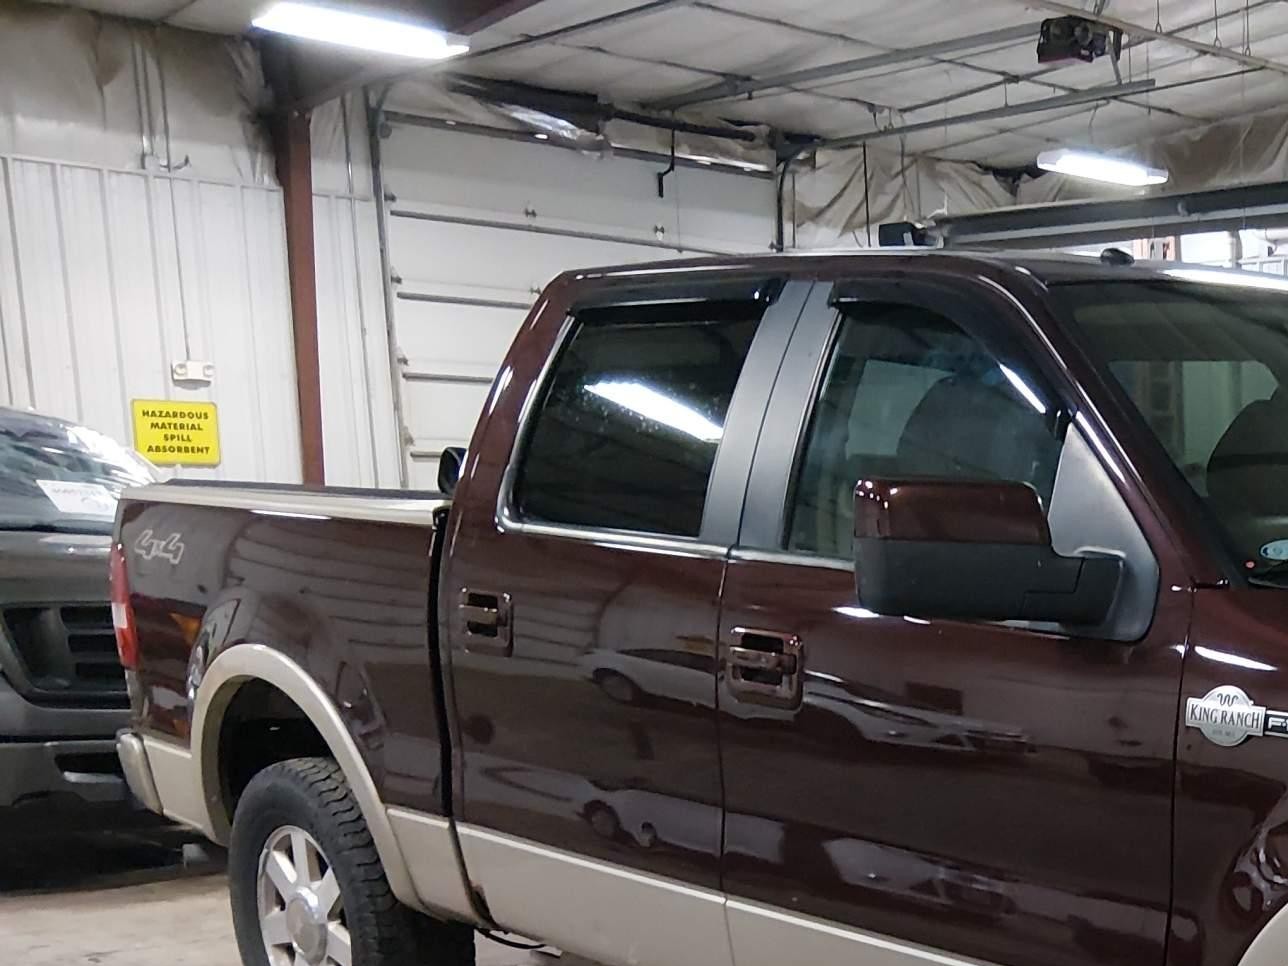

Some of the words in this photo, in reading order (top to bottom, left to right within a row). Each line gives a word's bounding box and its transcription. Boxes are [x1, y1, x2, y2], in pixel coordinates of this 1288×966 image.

[142, 409, 209, 420] HAZARDOUS
[150, 422, 204, 431] MATERIAL
[163, 433, 192, 442] SPILL
[146, 445, 210, 455] ABSORBENT
[1190, 703, 1218, 723] KING
[1220, 709, 1260, 729] RANCH
